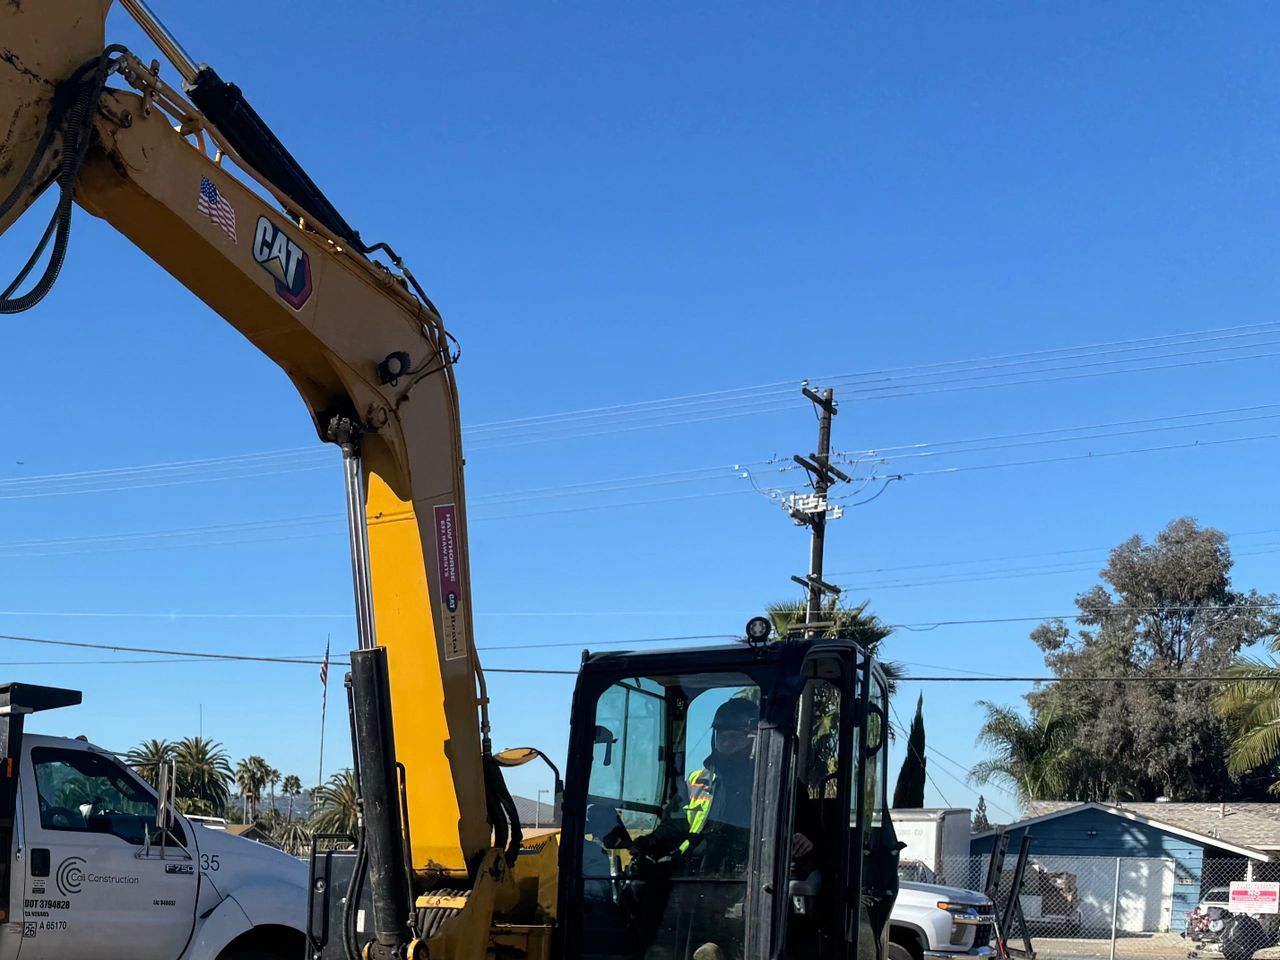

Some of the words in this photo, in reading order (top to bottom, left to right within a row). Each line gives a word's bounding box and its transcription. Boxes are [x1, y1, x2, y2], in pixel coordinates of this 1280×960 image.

[253, 216, 303, 289] CAT
[445, 513, 456, 583] HAWTHORNE
[448, 594, 456, 609] CAT
[200, 853, 220, 872] 35
[87, 873, 139, 884] Construction
[24, 899, 39, 909] DOT
[24, 926, 35, 937] 26
[39, 921, 45, 930] A
[46, 921, 67, 930] 65170
